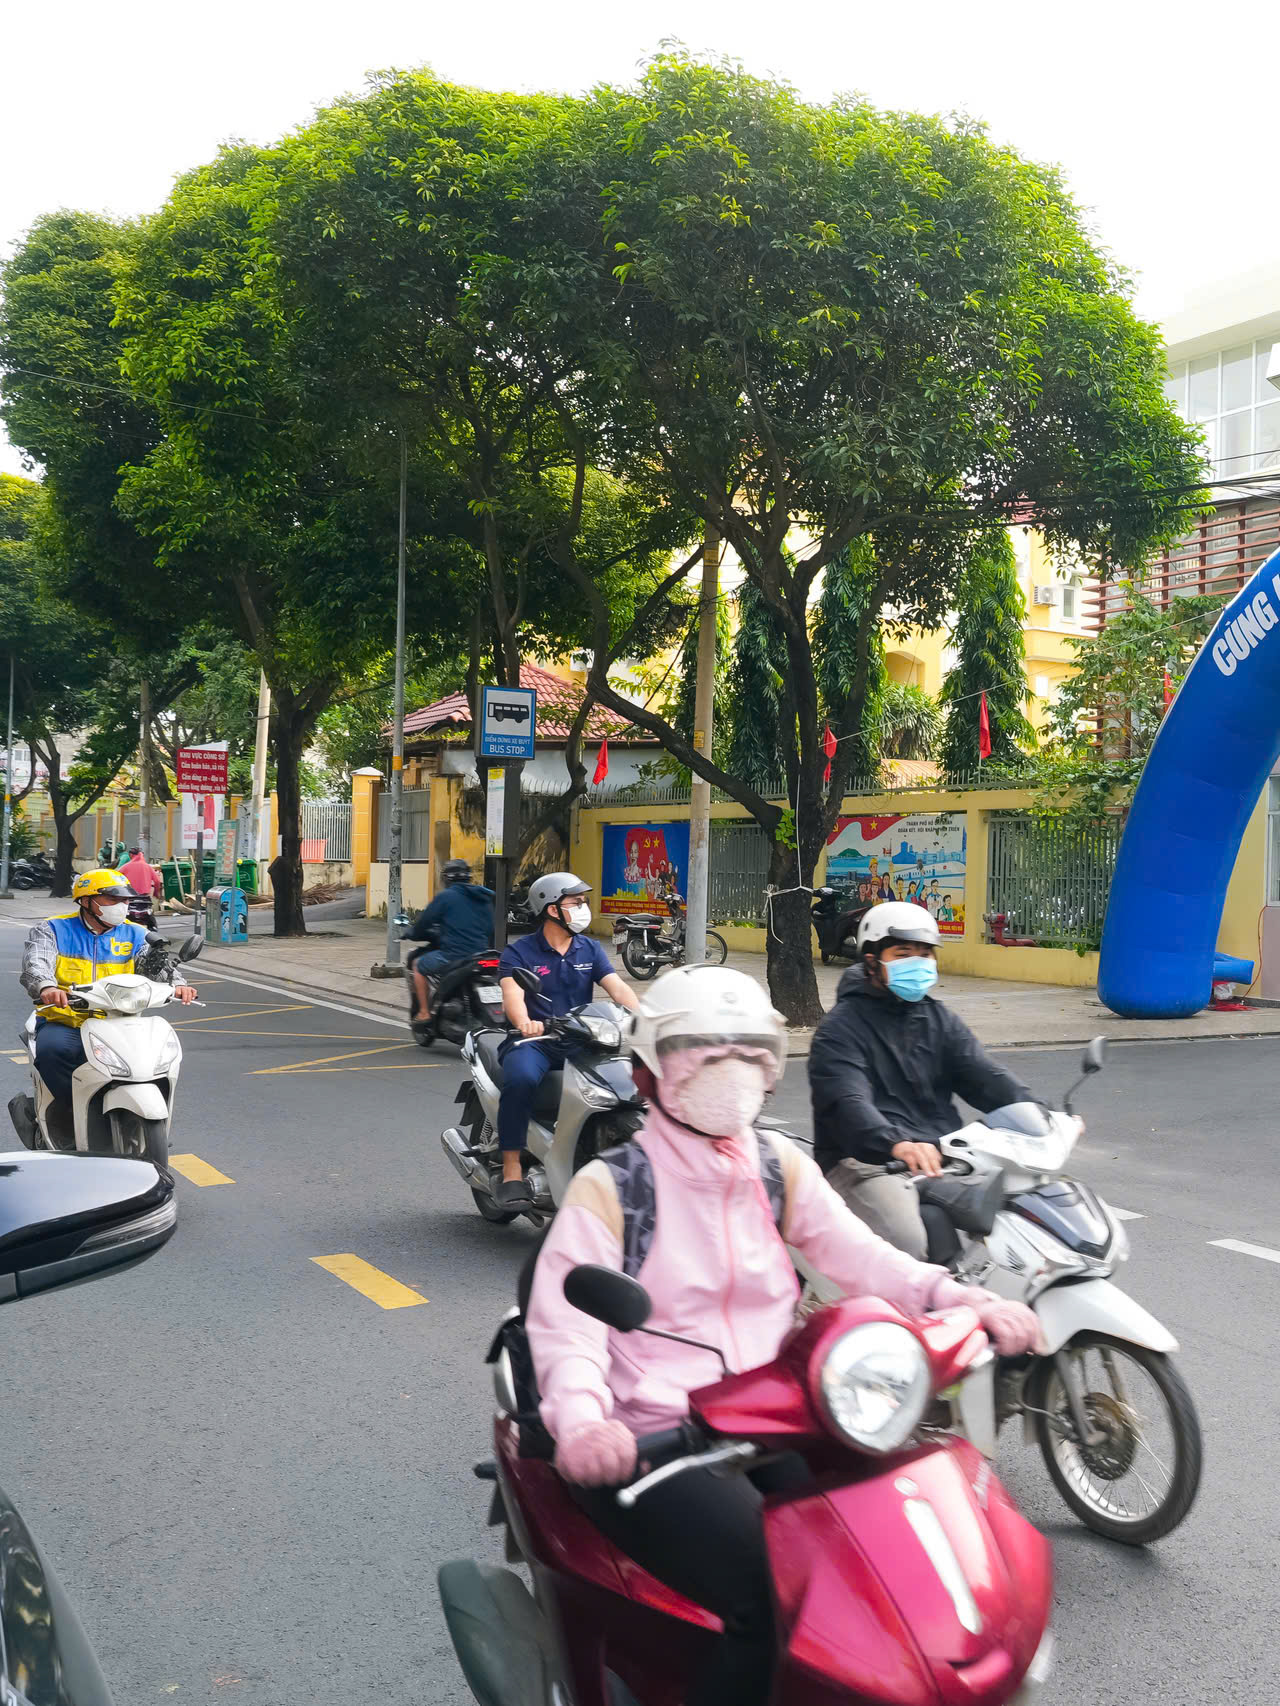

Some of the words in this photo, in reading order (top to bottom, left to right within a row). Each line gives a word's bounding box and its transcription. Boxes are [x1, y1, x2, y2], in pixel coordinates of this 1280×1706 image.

[1212, 591, 1280, 677] CÙNG
[489, 744, 505, 754] BUS
[506, 745, 525, 755] STOP
[110, 937, 133, 956] be
